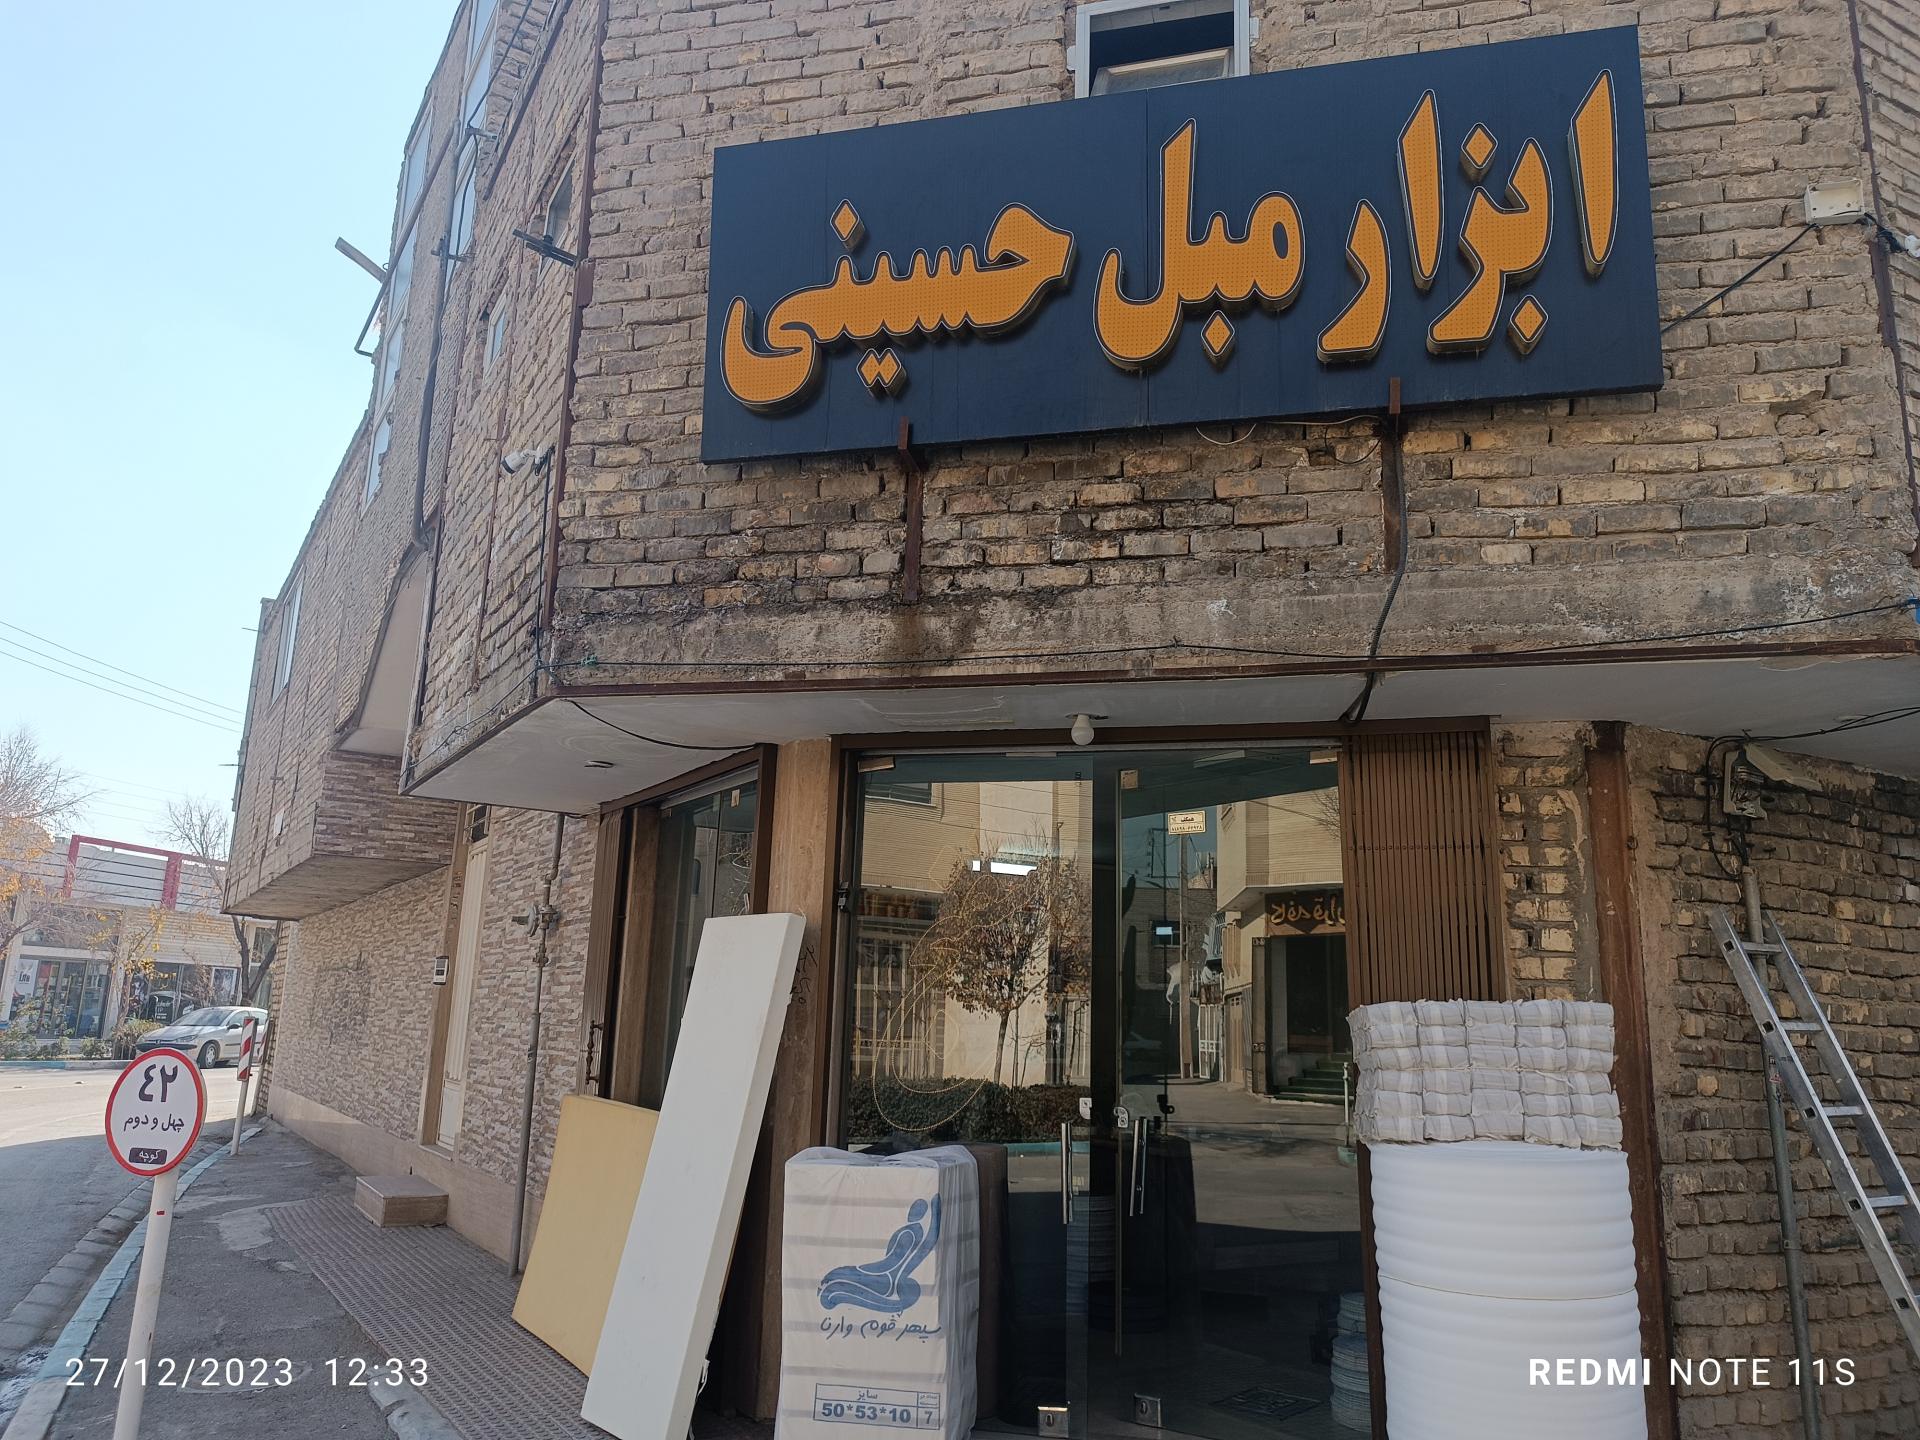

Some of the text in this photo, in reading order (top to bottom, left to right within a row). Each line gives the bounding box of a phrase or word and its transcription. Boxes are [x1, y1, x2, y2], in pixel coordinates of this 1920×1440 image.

[721, 68, 1619, 409] ابزار مبل حسینی
[123, 1113, 185, 1133] چهل و دوم
[138, 1149, 161, 1163] کوچه
[860, 1314, 897, 1339] فوم
[896, 1322, 942, 1344] سپهر
[857, 1389, 878, 1401] سایز
[924, 1411, 933, 1425] 7
